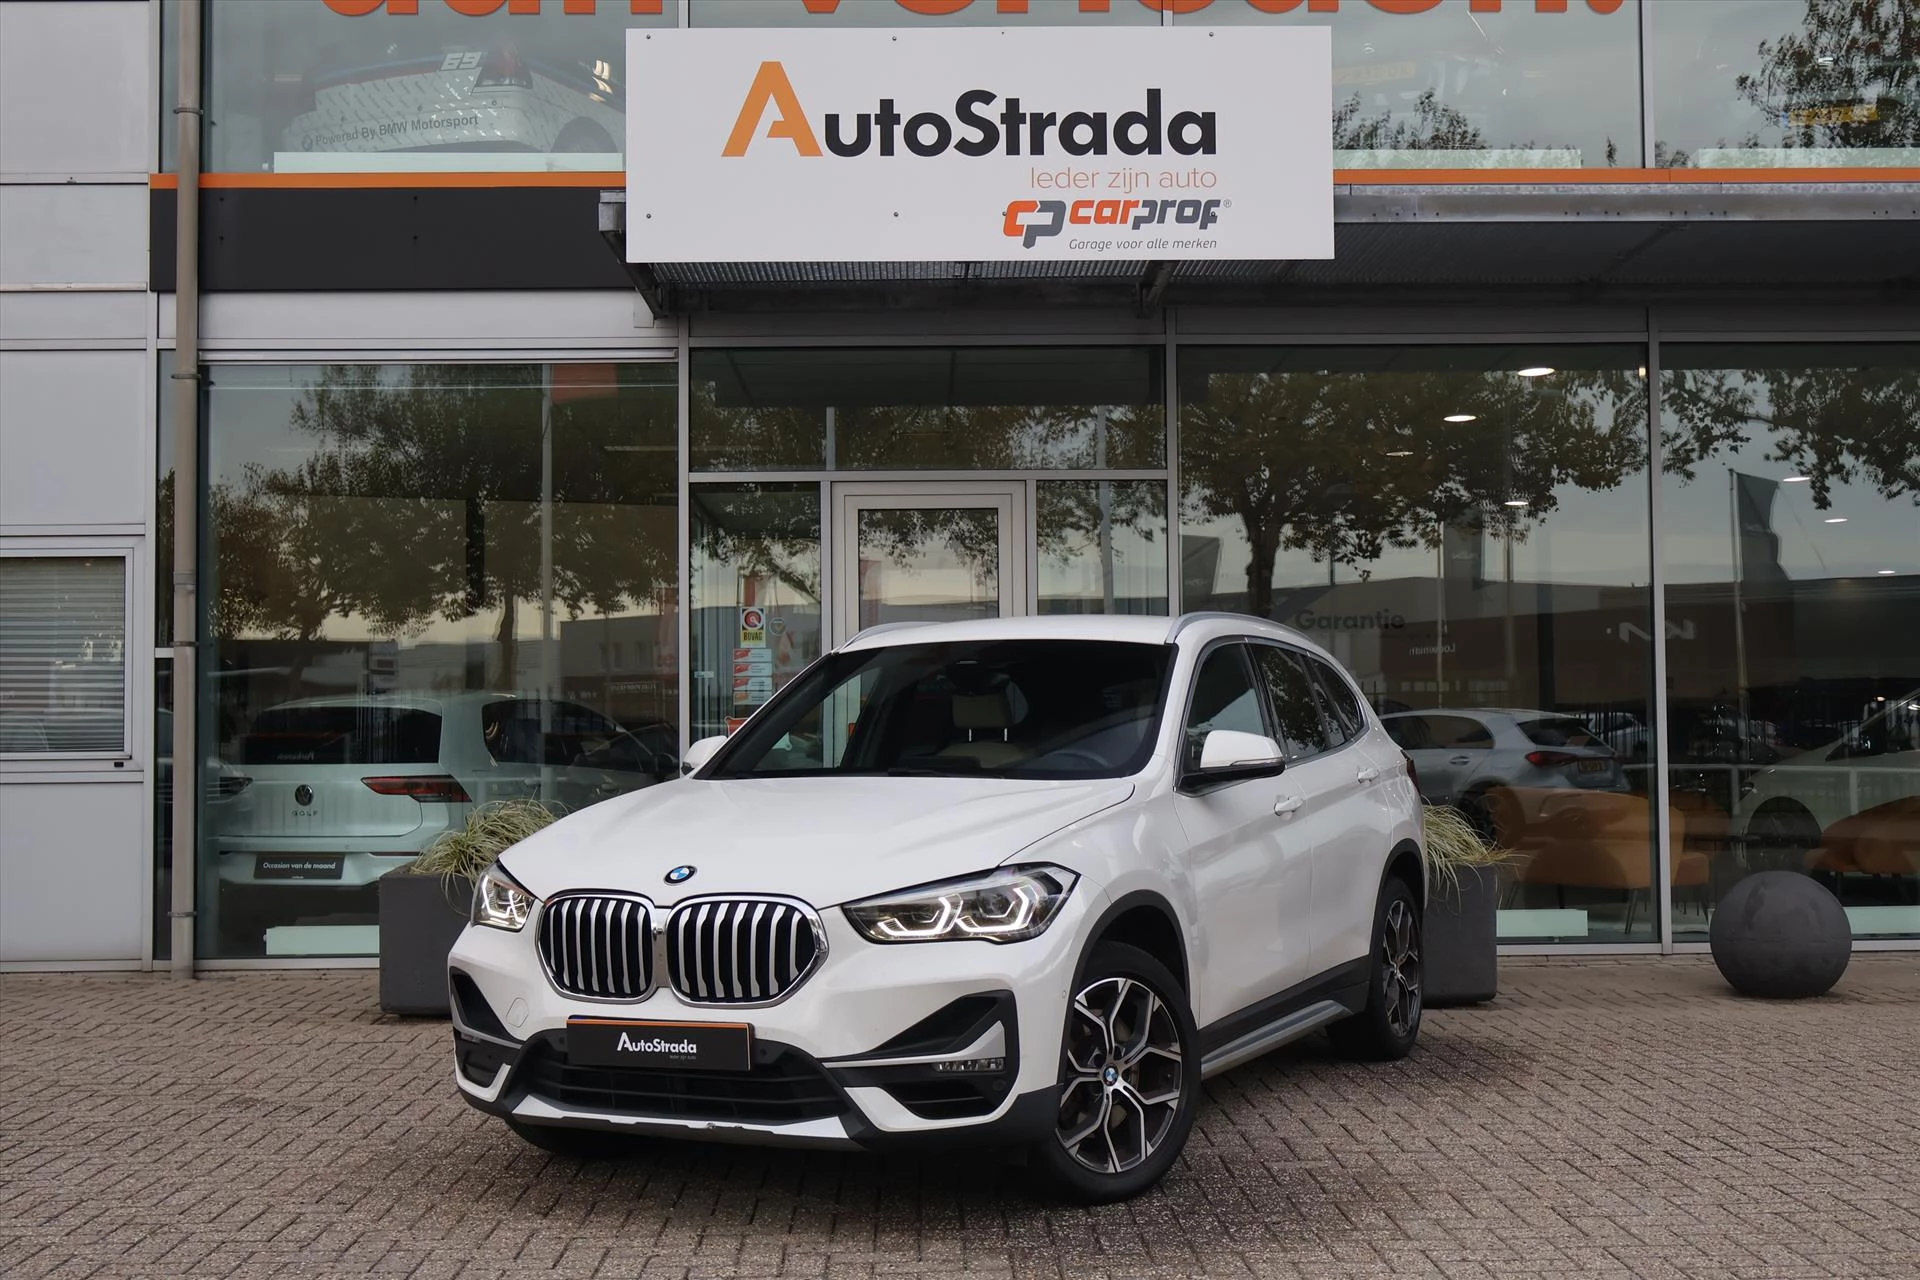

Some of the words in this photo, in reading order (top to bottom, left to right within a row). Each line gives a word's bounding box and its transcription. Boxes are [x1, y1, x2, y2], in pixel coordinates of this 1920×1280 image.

[440, 51, 483, 72] 69
[721, 61, 1218, 158] AutoStrada
[315, 127, 358, 146] Powered
[361, 126, 377, 141] By
[379, 121, 408, 136] BMW
[411, 115, 479, 132] Motorsport
[1031, 166, 1100, 189] Ieder
[1107, 167, 1150, 194] zijn
[1159, 167, 1218, 189] auto
[1069, 238, 1112, 252] Garage
[1116, 240, 1143, 250] voor
[1146, 238, 1170, 250] alle
[1172, 238, 1218, 250] merken
[1295, 608, 1406, 630] Garantie
[743, 631, 763, 641] BOVAG
[263, 861, 290, 870] Occasion
[291, 862, 303, 870] van
[304, 861, 312, 870] de
[312, 861, 336, 870] maand
[616, 1031, 697, 1054] AutoStrada
